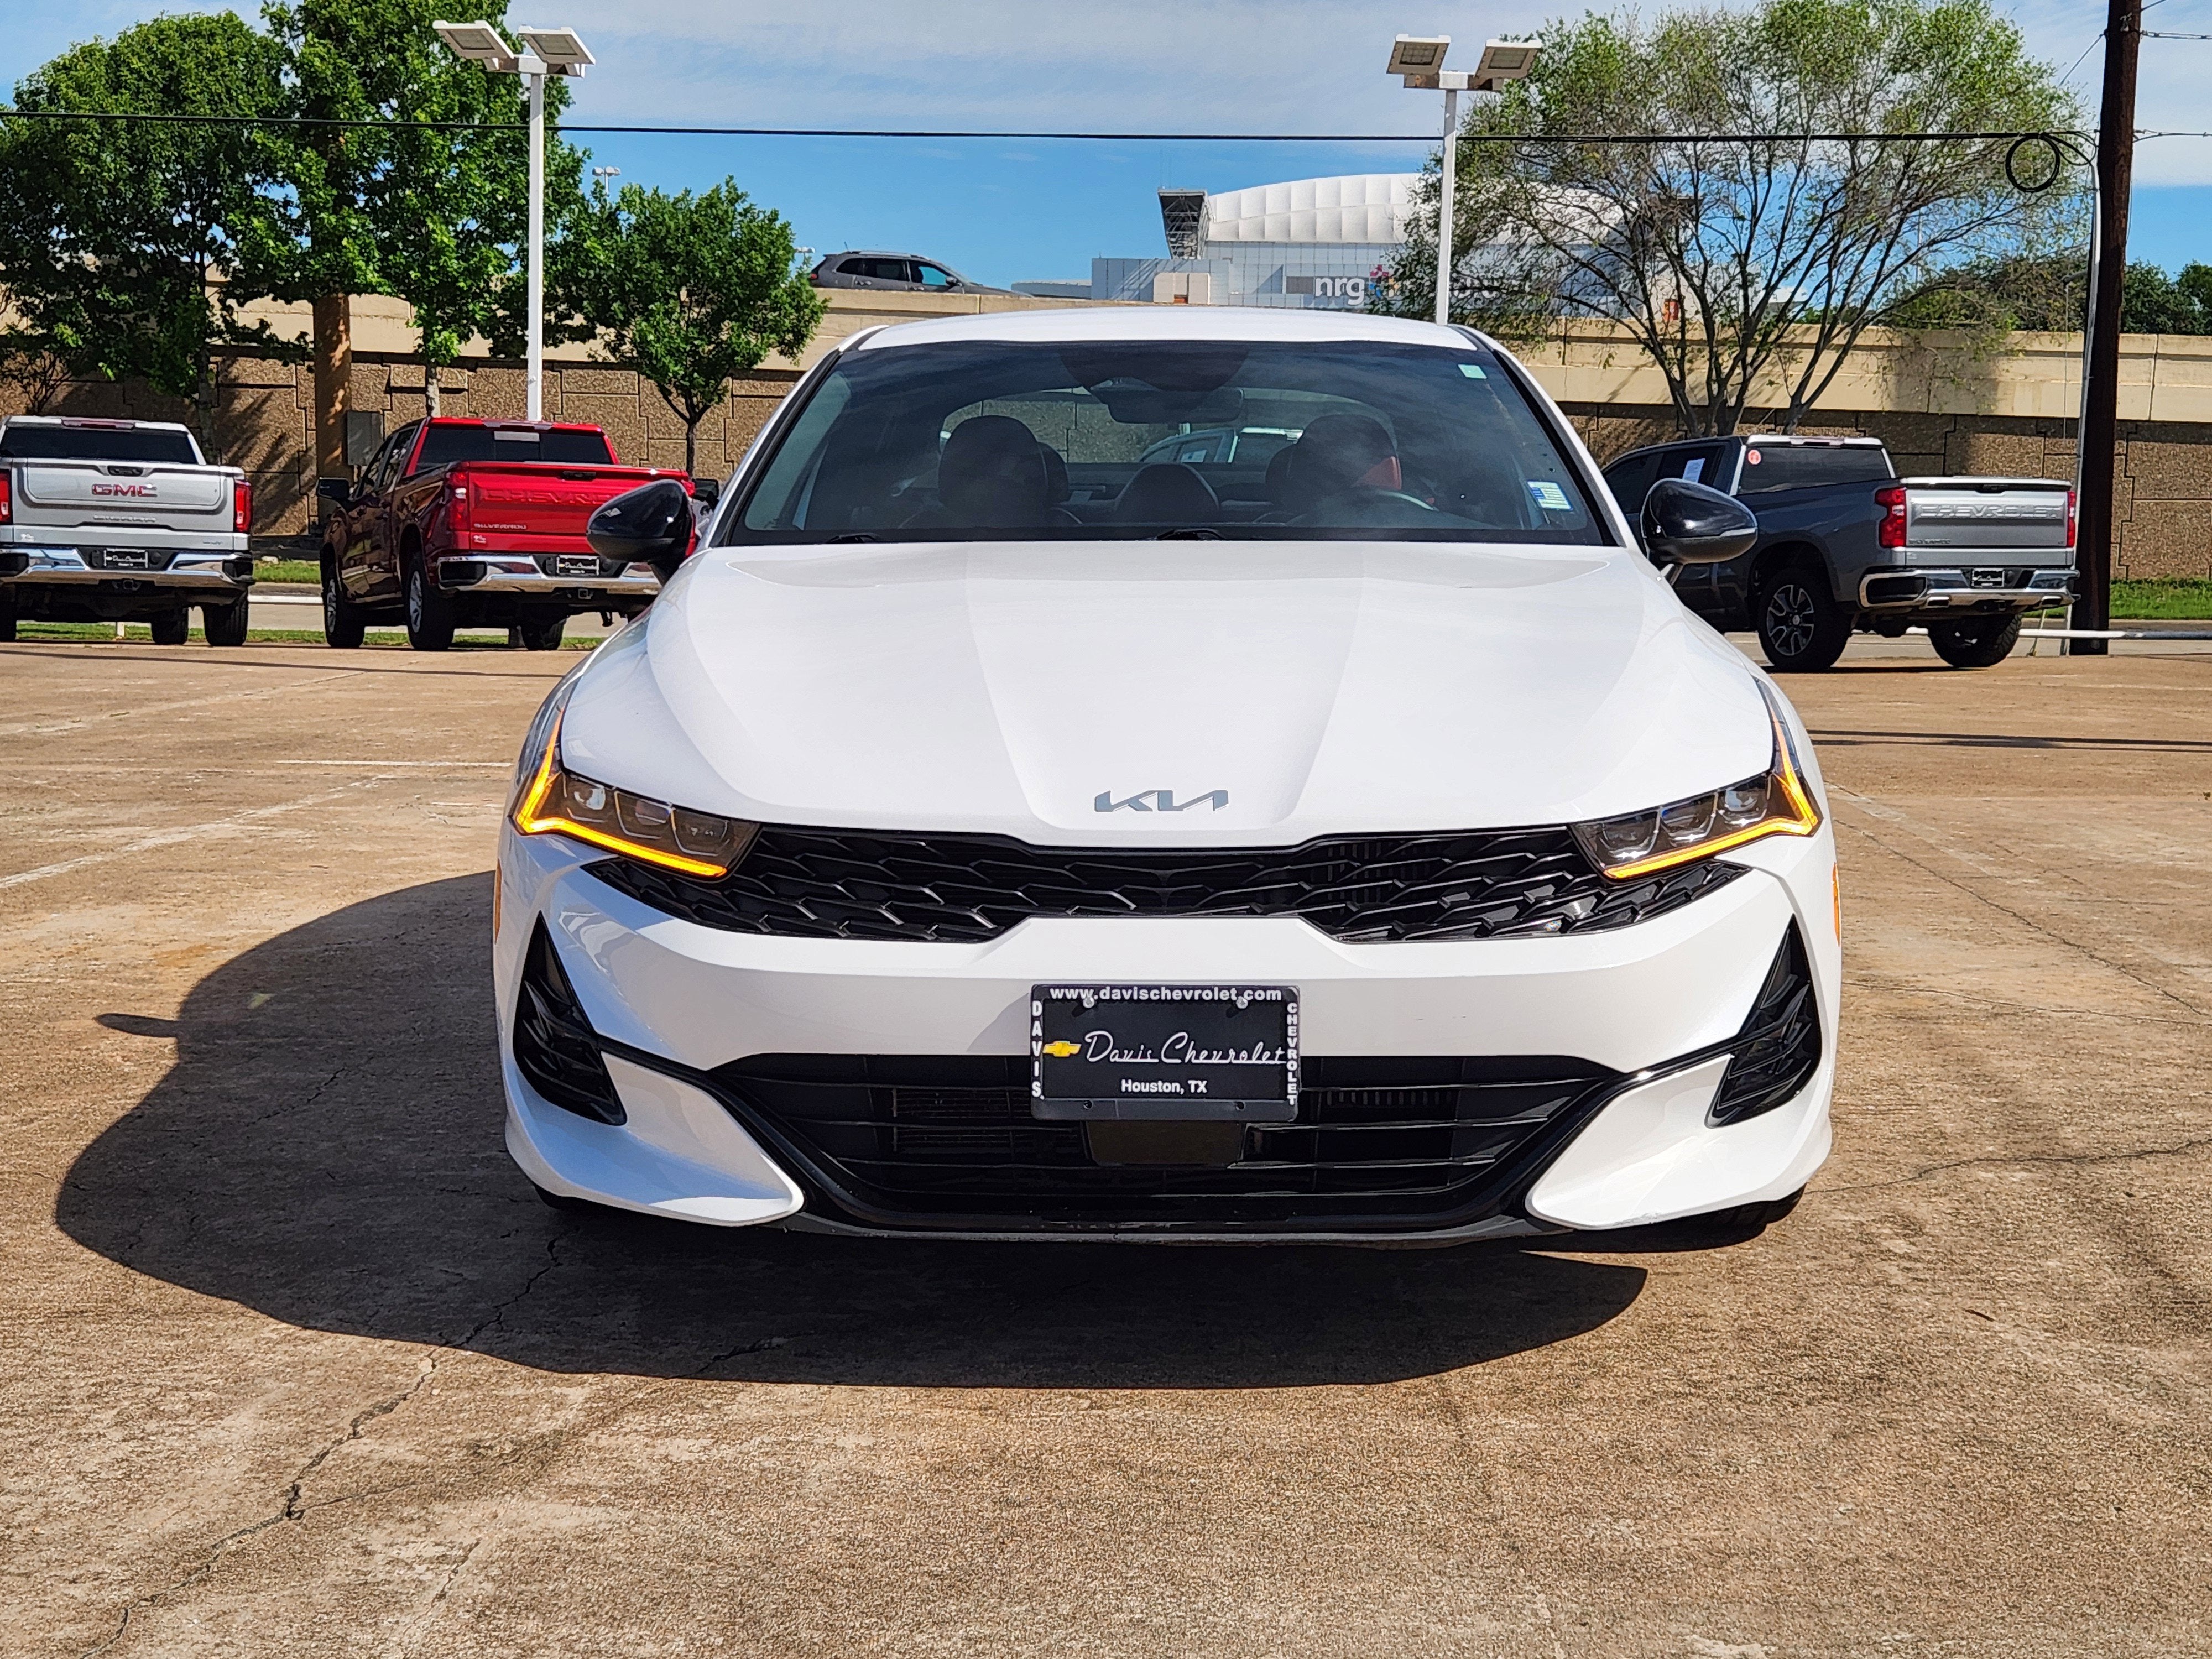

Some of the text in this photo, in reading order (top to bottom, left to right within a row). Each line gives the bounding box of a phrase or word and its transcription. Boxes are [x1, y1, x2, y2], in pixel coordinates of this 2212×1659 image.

[1315, 277, 1365, 305] nrg
[92, 483, 158, 498] GMC
[1920, 504, 2063, 518] CHEVROLET
[1094, 790, 1229, 812] KIA
[1050, 986, 1282, 1001] www.davischevrolet.com
[1084, 1030, 1287, 1064] Davis Chevrolet
[1286, 1002, 1298, 1105] CHEVROLET
[1121, 1079, 1207, 1094] Houston, TX
